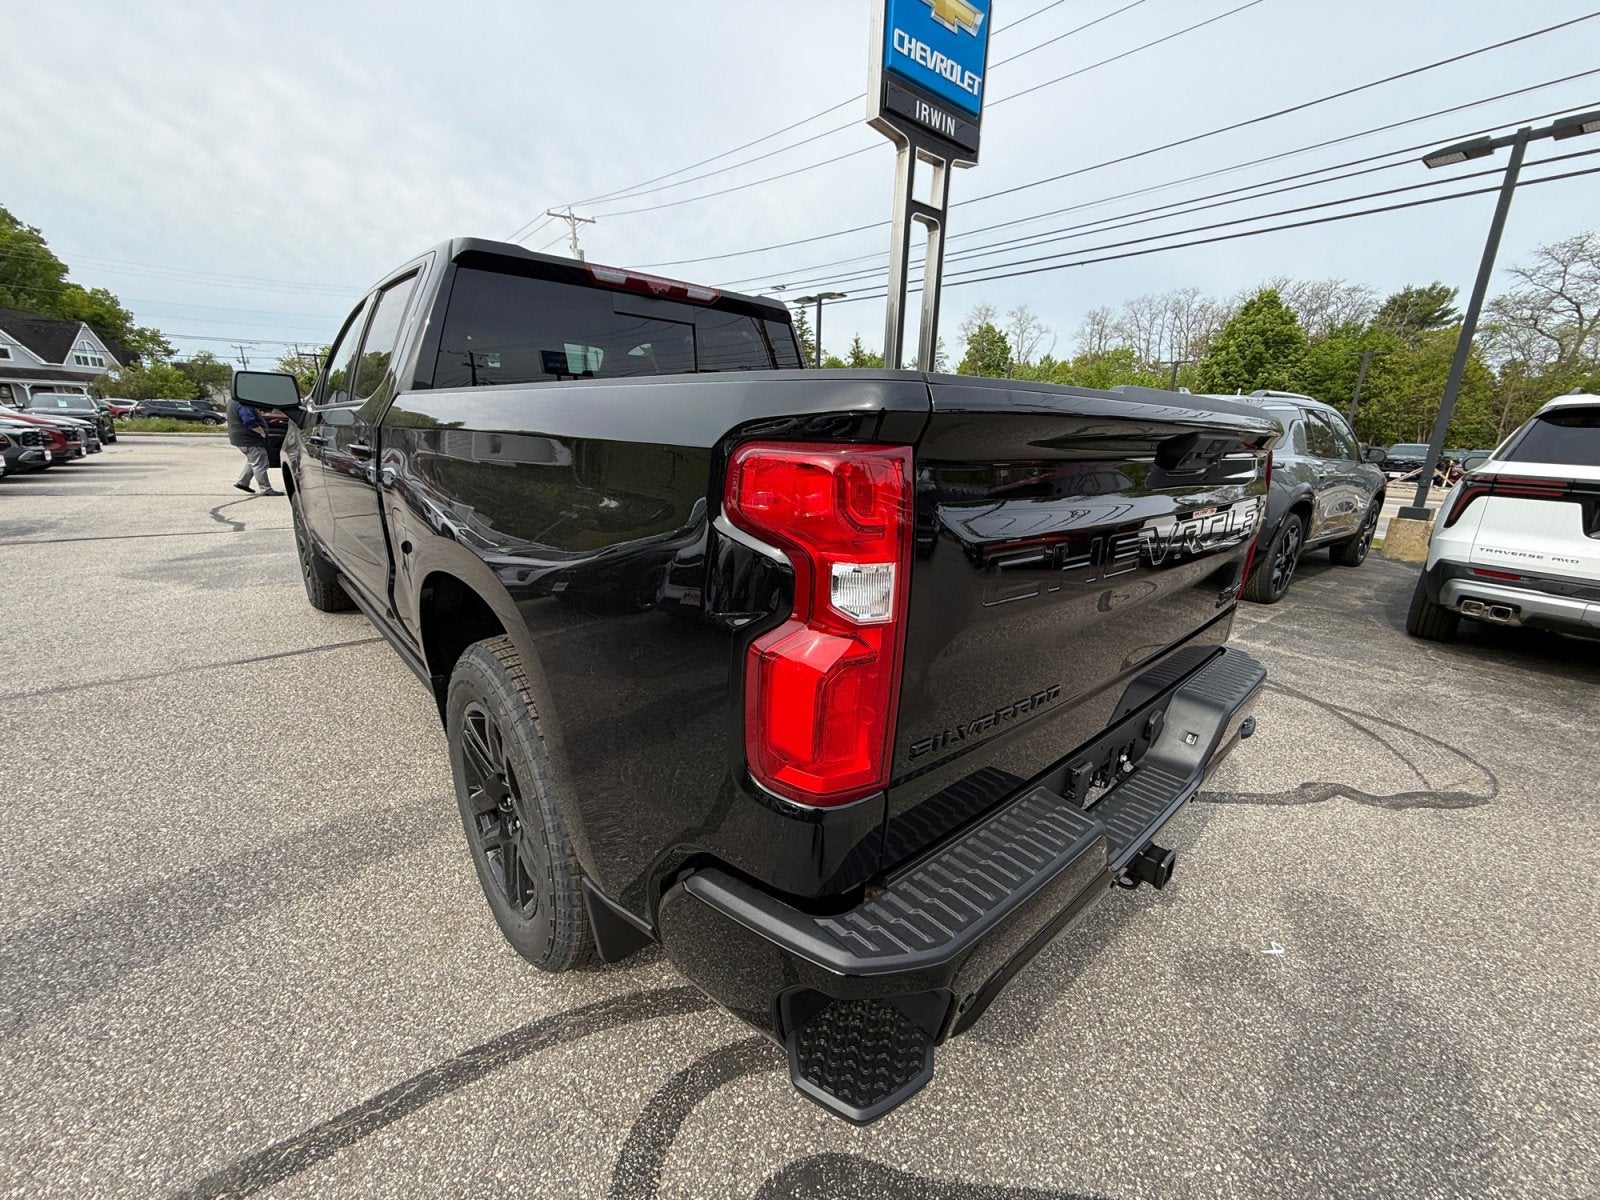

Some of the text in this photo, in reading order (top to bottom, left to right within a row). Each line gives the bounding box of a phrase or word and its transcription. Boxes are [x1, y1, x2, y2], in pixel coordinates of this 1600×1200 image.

[893, 28, 982, 96] CHEVROLET
[915, 100, 956, 137] IRWIN
[1479, 547, 1544, 560] TRAVERSE
[908, 684, 1062, 760] SILVERADO
